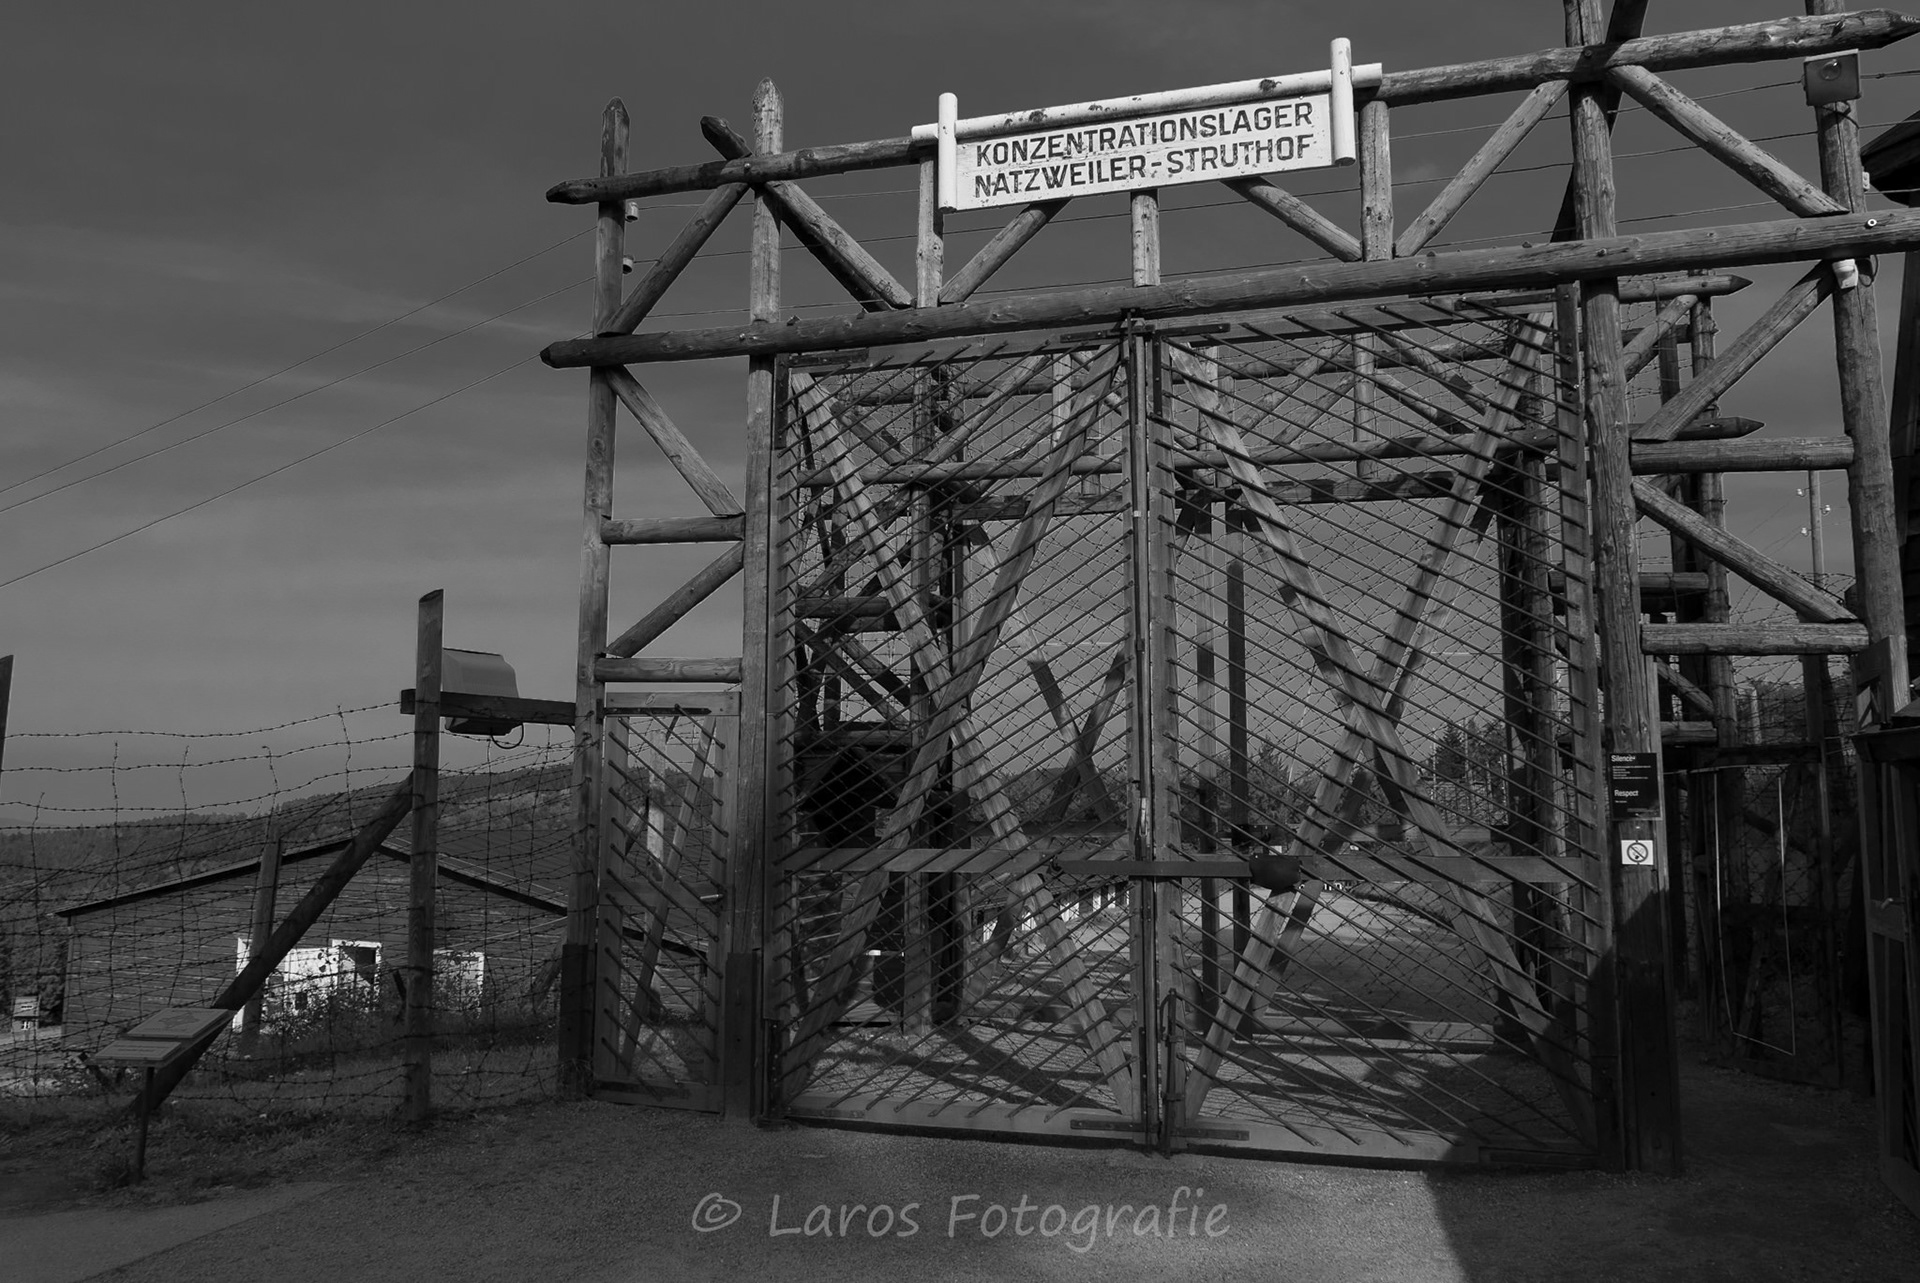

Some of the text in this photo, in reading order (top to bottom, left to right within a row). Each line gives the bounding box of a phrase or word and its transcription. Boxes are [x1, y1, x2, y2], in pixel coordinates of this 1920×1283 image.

[974, 133, 1314, 198] NATZWEILER-STRUTHOF
[976, 101, 1313, 167] KONZENTRATIONSLAGER
[1614, 789, 1639, 797] Respect
